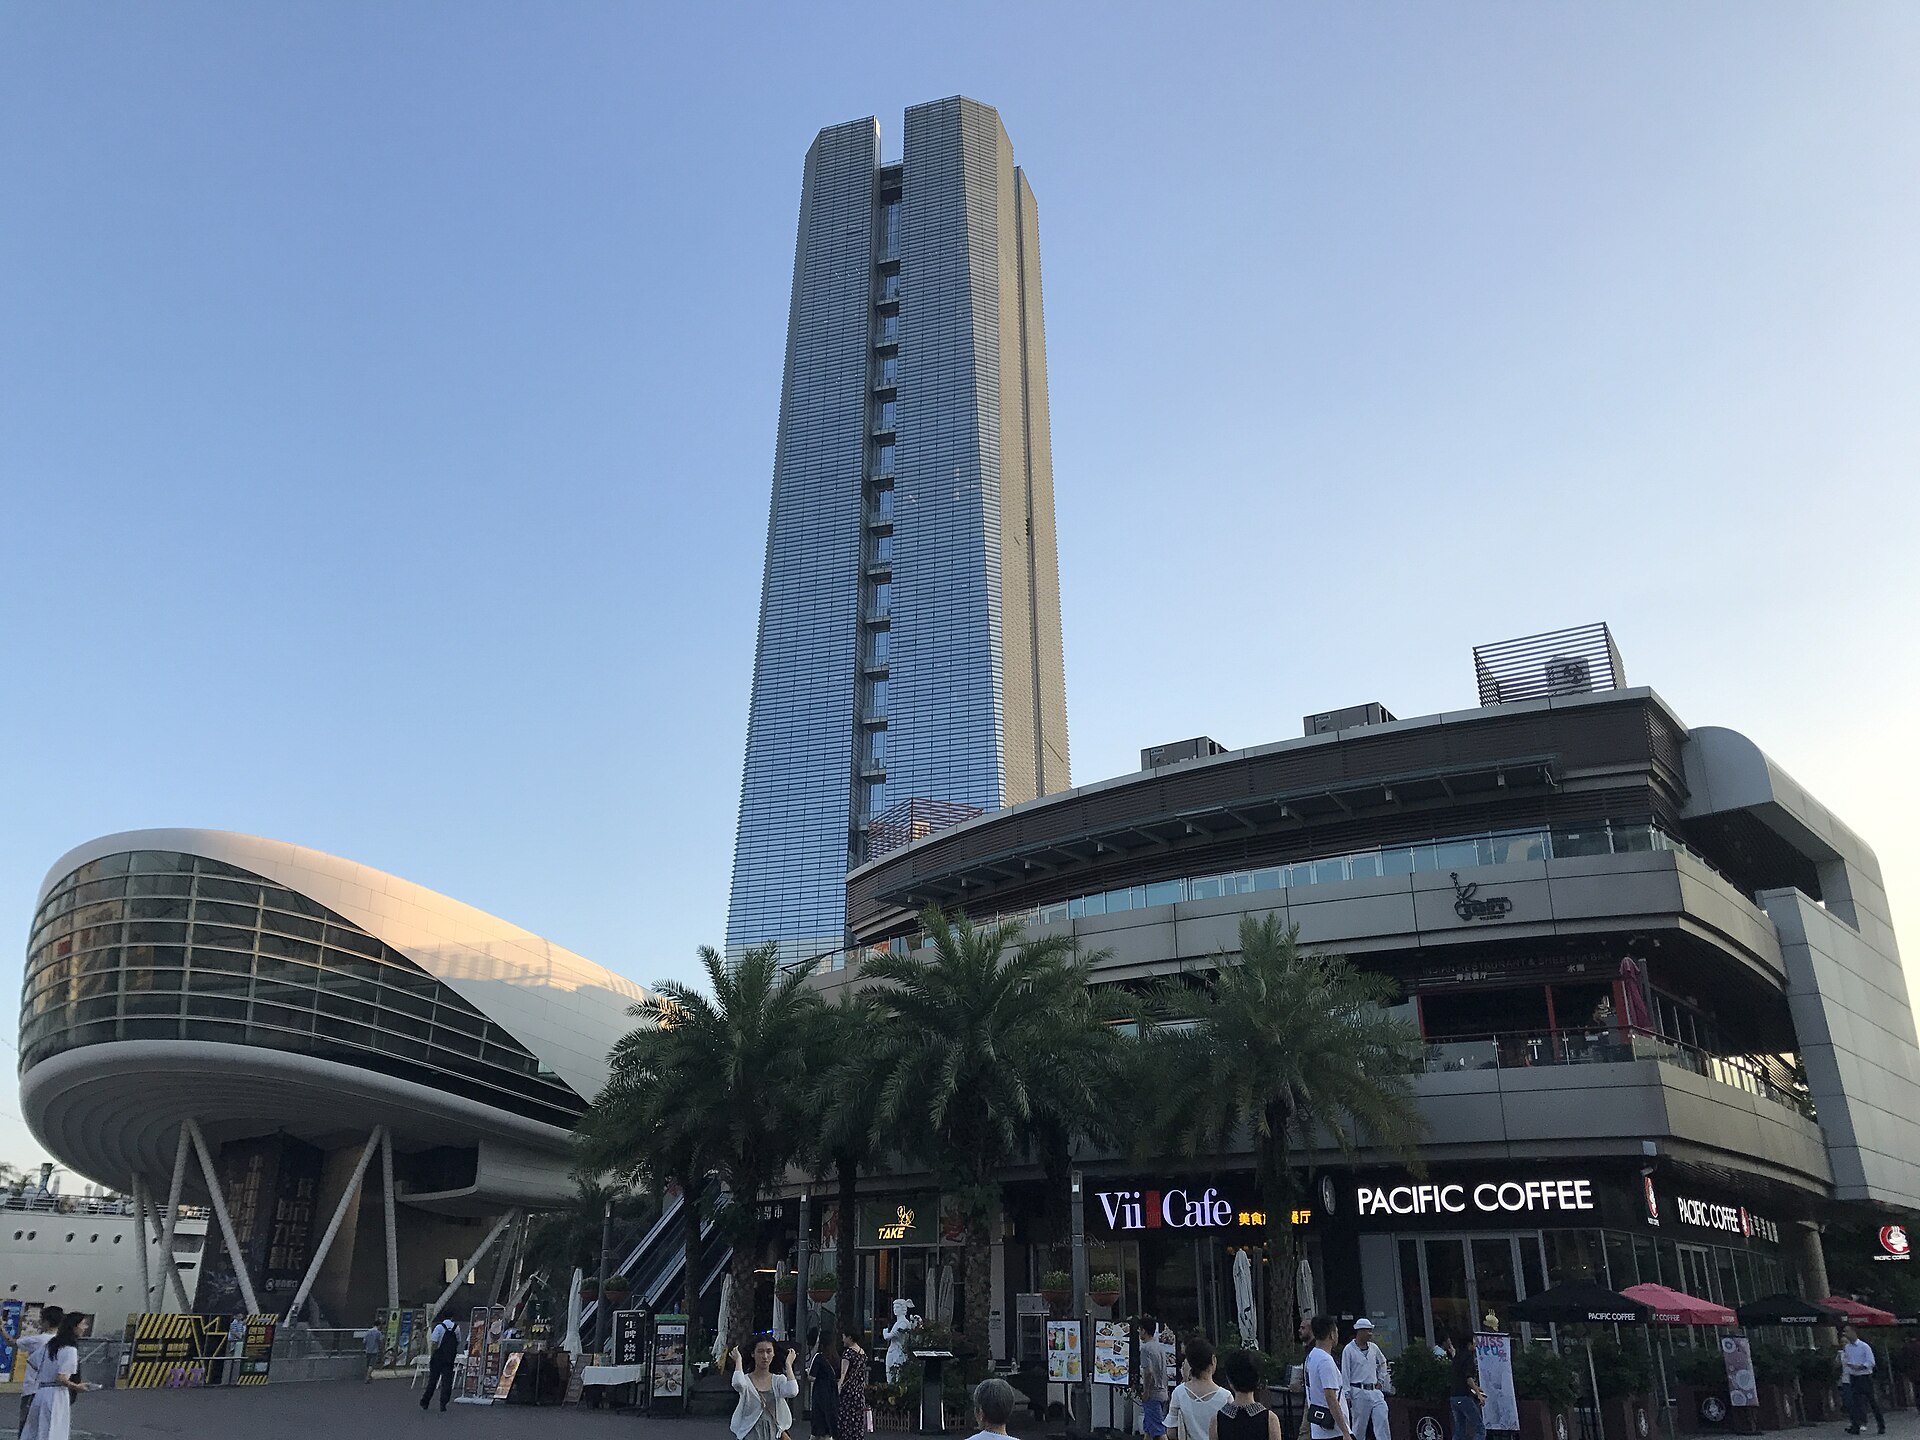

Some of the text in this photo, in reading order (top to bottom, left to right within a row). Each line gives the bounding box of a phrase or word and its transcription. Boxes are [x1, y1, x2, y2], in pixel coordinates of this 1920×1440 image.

[1095, 1188, 1232, 1230] Vii Cafe
[1357, 1180, 1594, 1215] PACIFIC COFFEE
[1678, 1197, 1740, 1233] PACIFIC COFFEE
[878, 1227, 905, 1240] TAKE
[1588, 1312, 1636, 1321] PACIFIC COFFEE
[1659, 1313, 1680, 1321] COFFEE
